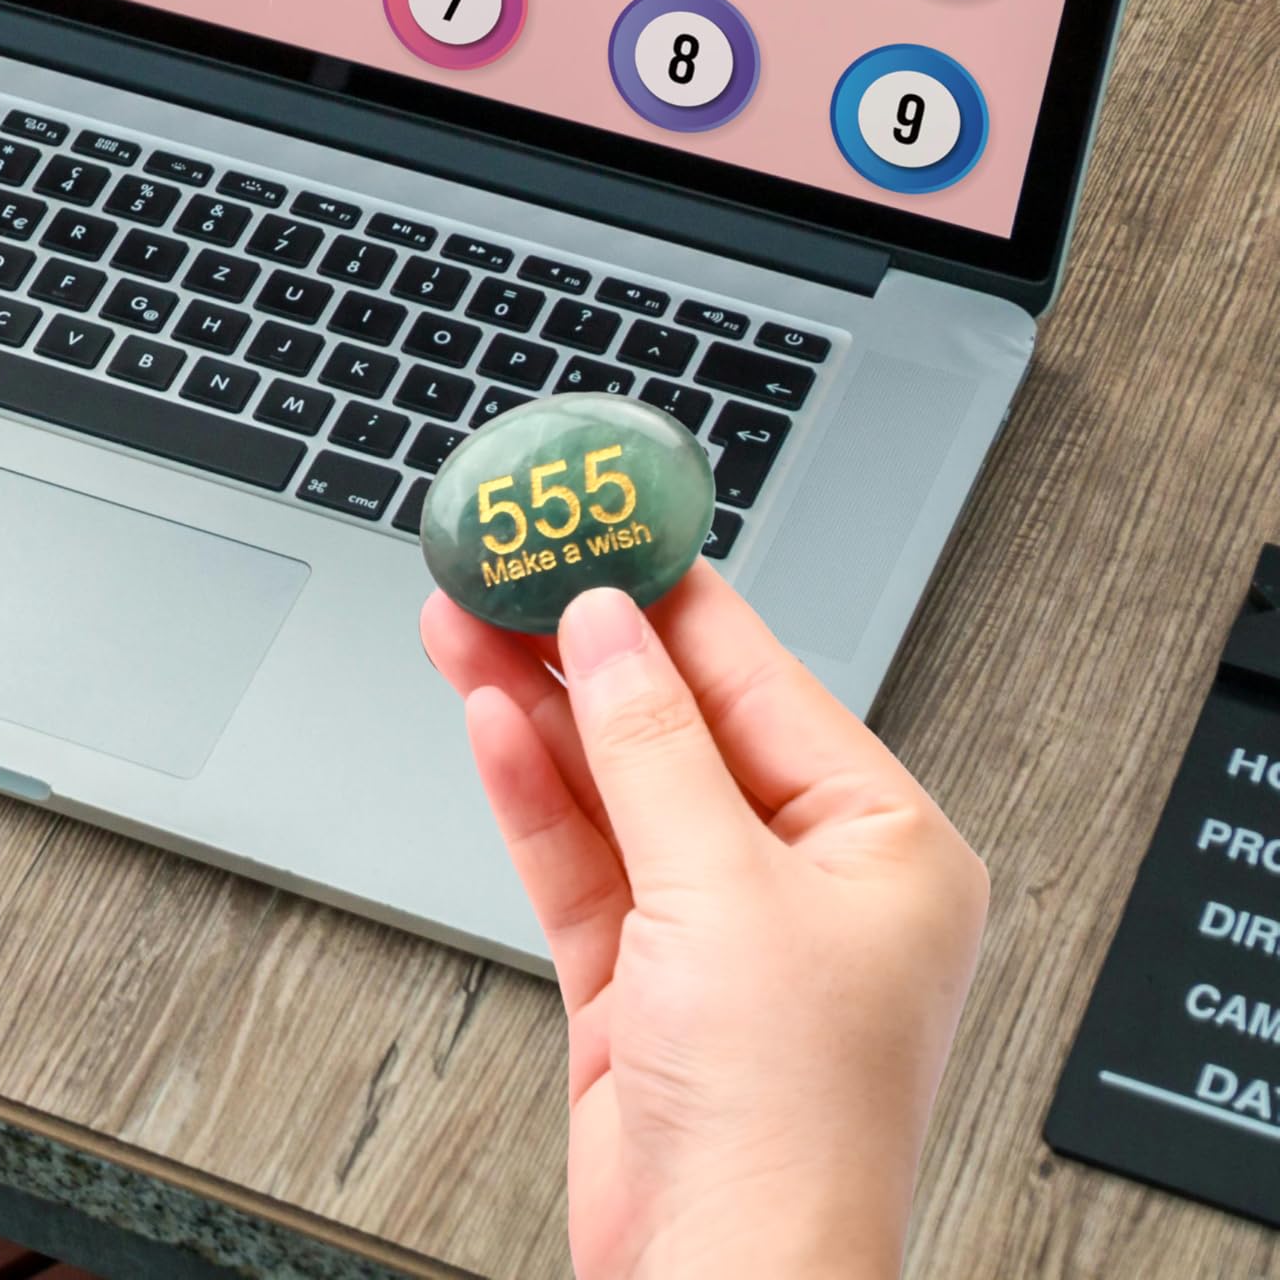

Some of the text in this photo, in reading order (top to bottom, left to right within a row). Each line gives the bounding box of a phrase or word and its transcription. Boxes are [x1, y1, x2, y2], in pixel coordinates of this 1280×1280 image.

[669, 34, 699, 84] 8
[894, 94, 924, 144] 9
[62, 180, 74, 190] 4
[141, 184, 153, 197] %
[2, 205, 15, 218] E
[131, 199, 144, 211] 5
[211, 205, 223, 216] &
[71, 225, 86, 239] R
[203, 220, 214, 231] 6
[275, 239, 288, 250] 7
[145, 246, 157, 258] T
[347, 261, 360, 272] 8
[213, 267, 230, 280] Z
[61, 276, 75, 287] F
[422, 282, 433, 293] 9
[286, 287, 303, 300] U
[131, 296, 147, 310] G
[495, 304, 508, 315] 0
[143, 308, 158, 321] @
[582, 310, 592, 321] ?
[202, 317, 221, 332] H
[69, 331, 83, 345] V
[434, 331, 451, 344] O
[278, 340, 291, 352] J
[139, 354, 153, 367] B
[510, 352, 526, 364] P
[351, 361, 368, 376] K
[210, 375, 229, 390] N
[427, 383, 437, 397] L
[283, 397, 304, 413] M
[349, 496, 378, 509] cmd
[478, 444, 637, 555] 555
[481, 522, 652, 587] Make a wish
